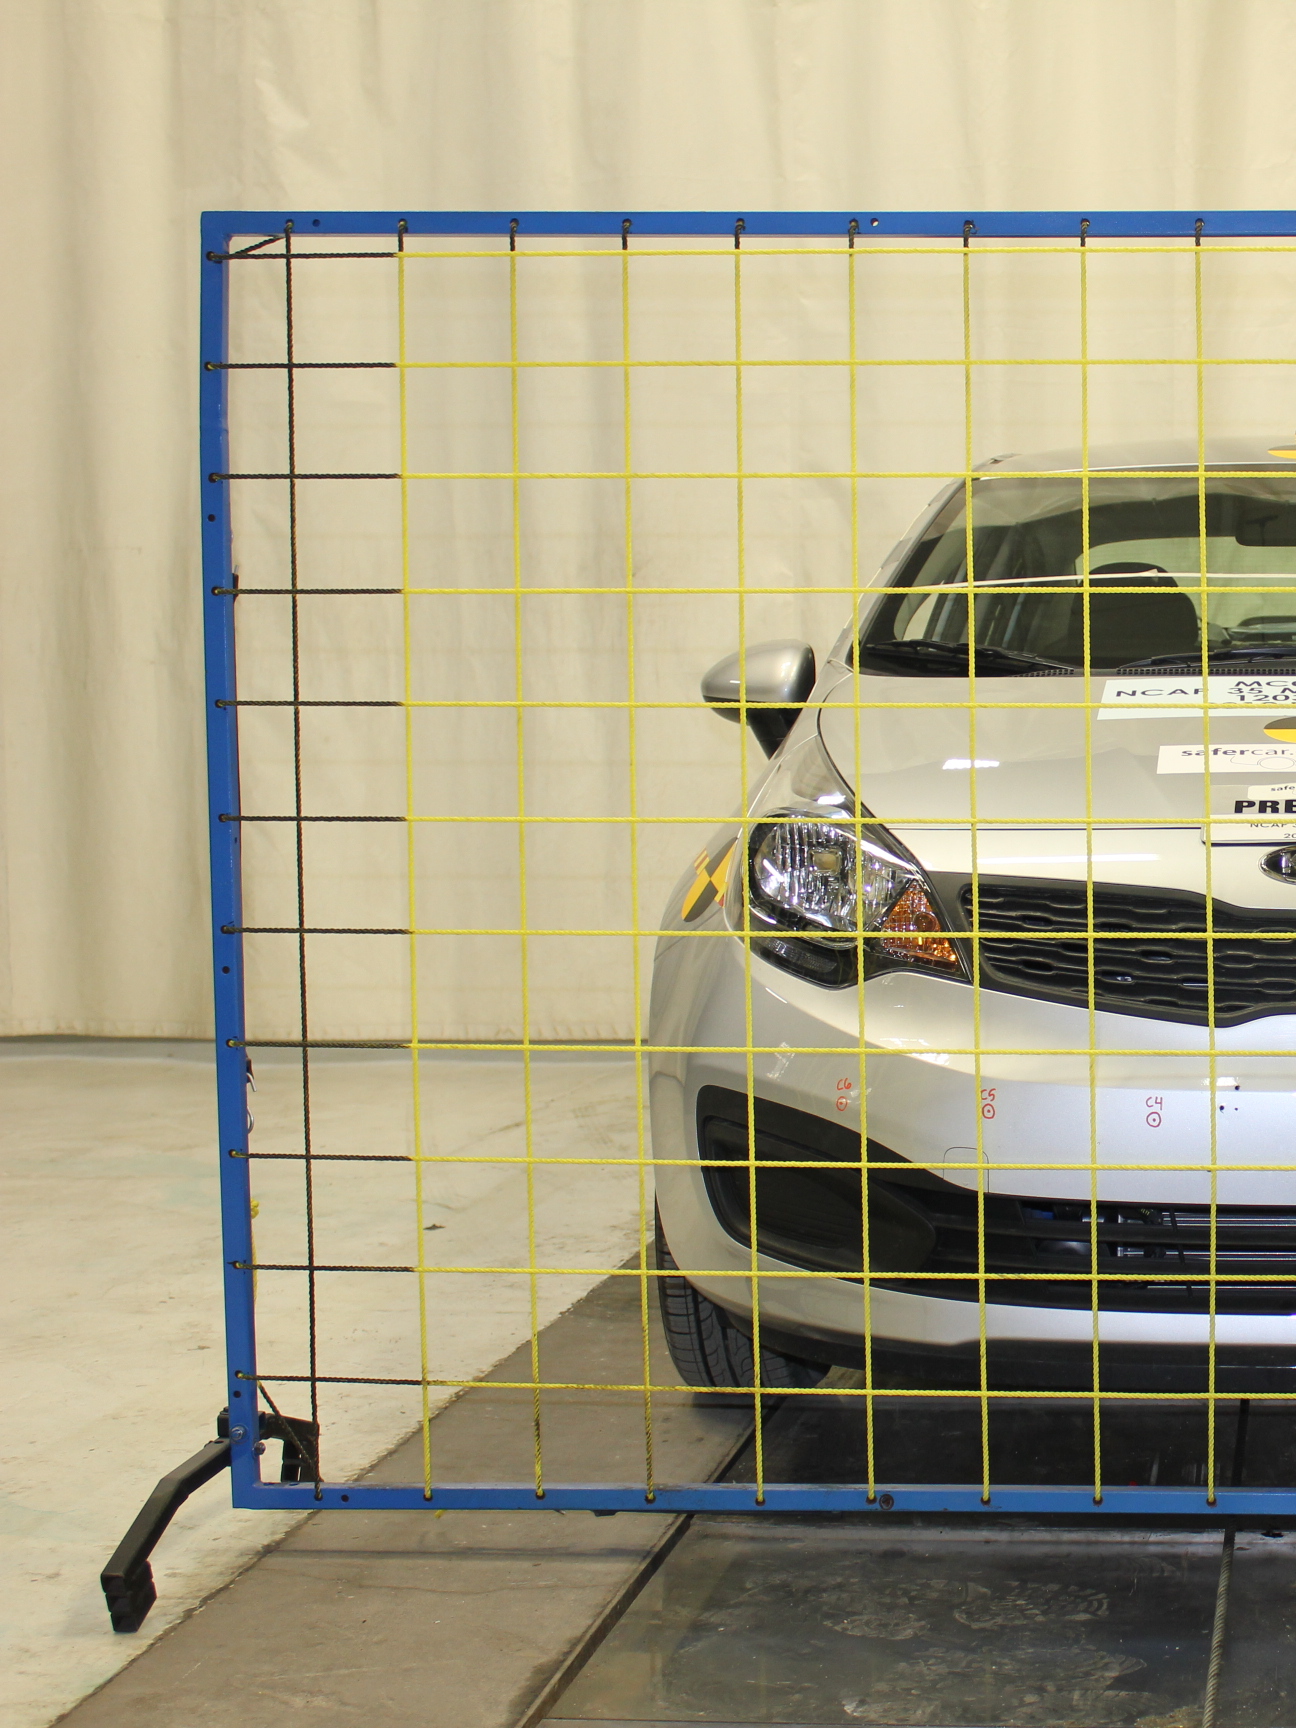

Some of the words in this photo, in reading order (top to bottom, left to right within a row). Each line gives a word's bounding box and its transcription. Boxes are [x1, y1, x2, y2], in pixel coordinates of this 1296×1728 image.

[836, 1077, 853, 1091] C6
[980, 1088, 997, 1102] C5
[1145, 1096, 1163, 1111] C4
